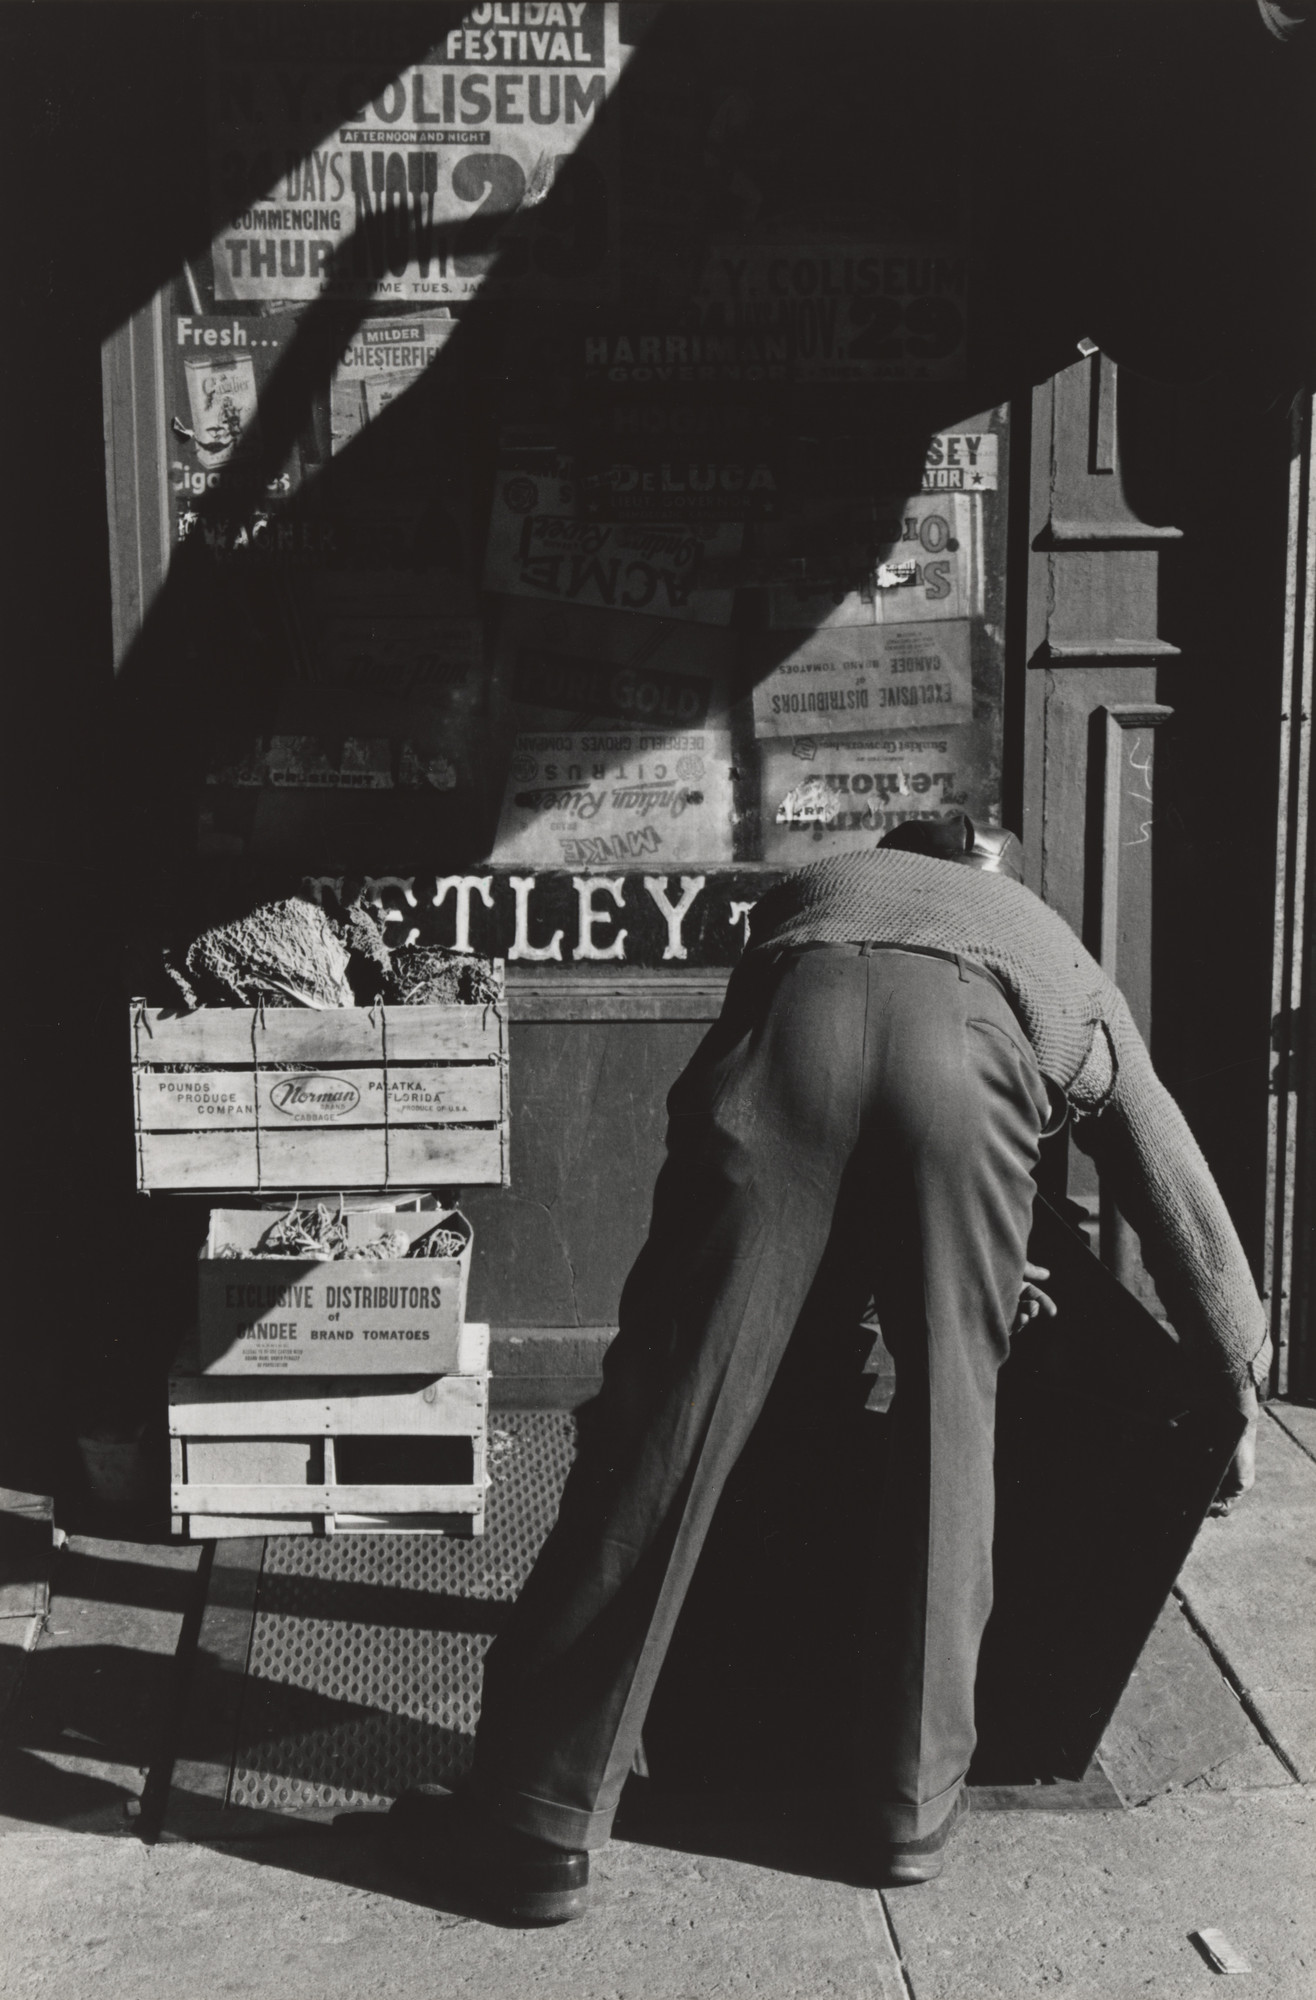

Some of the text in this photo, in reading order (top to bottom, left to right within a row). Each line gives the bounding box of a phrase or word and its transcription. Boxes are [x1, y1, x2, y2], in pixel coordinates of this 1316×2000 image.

[463, 2, 587, 27] OLIDAY
[447, 29, 592, 62] FESTIVAL
[344, 131, 487, 143] AFTERNOON AND NIGHT
[231, 209, 341, 231] COMMENCING
[413, 282, 453, 294] TUES.
[367, 329, 420, 343] MILDER
[780, 661, 838, 675] TOMATOES
[772, 683, 952, 715] EXCLUSIVE DISTRIBUTORS
[581, 736, 632, 751] GROVES
[637, 736, 705, 752] DEERFIELD
[543, 763, 669, 781] CITRUS
[558, 824, 664, 865] MIKE
[159, 1083, 211, 1093] POUNDS
[279, 1083, 356, 1106] Norman
[177, 1093, 237, 1103] PRODUCE
[387, 1093, 441, 1103] FLORIDA
[197, 1105, 263, 1115] COMPANY
[294, 1114, 337, 1122] CABBAGE
[225, 1285, 442, 1309] EXCLUSIVE DISTRIBUTORS
[328, 1312, 339, 1322] of
[237, 1322, 430, 1341] CANDEE BRAND TOMATOES
